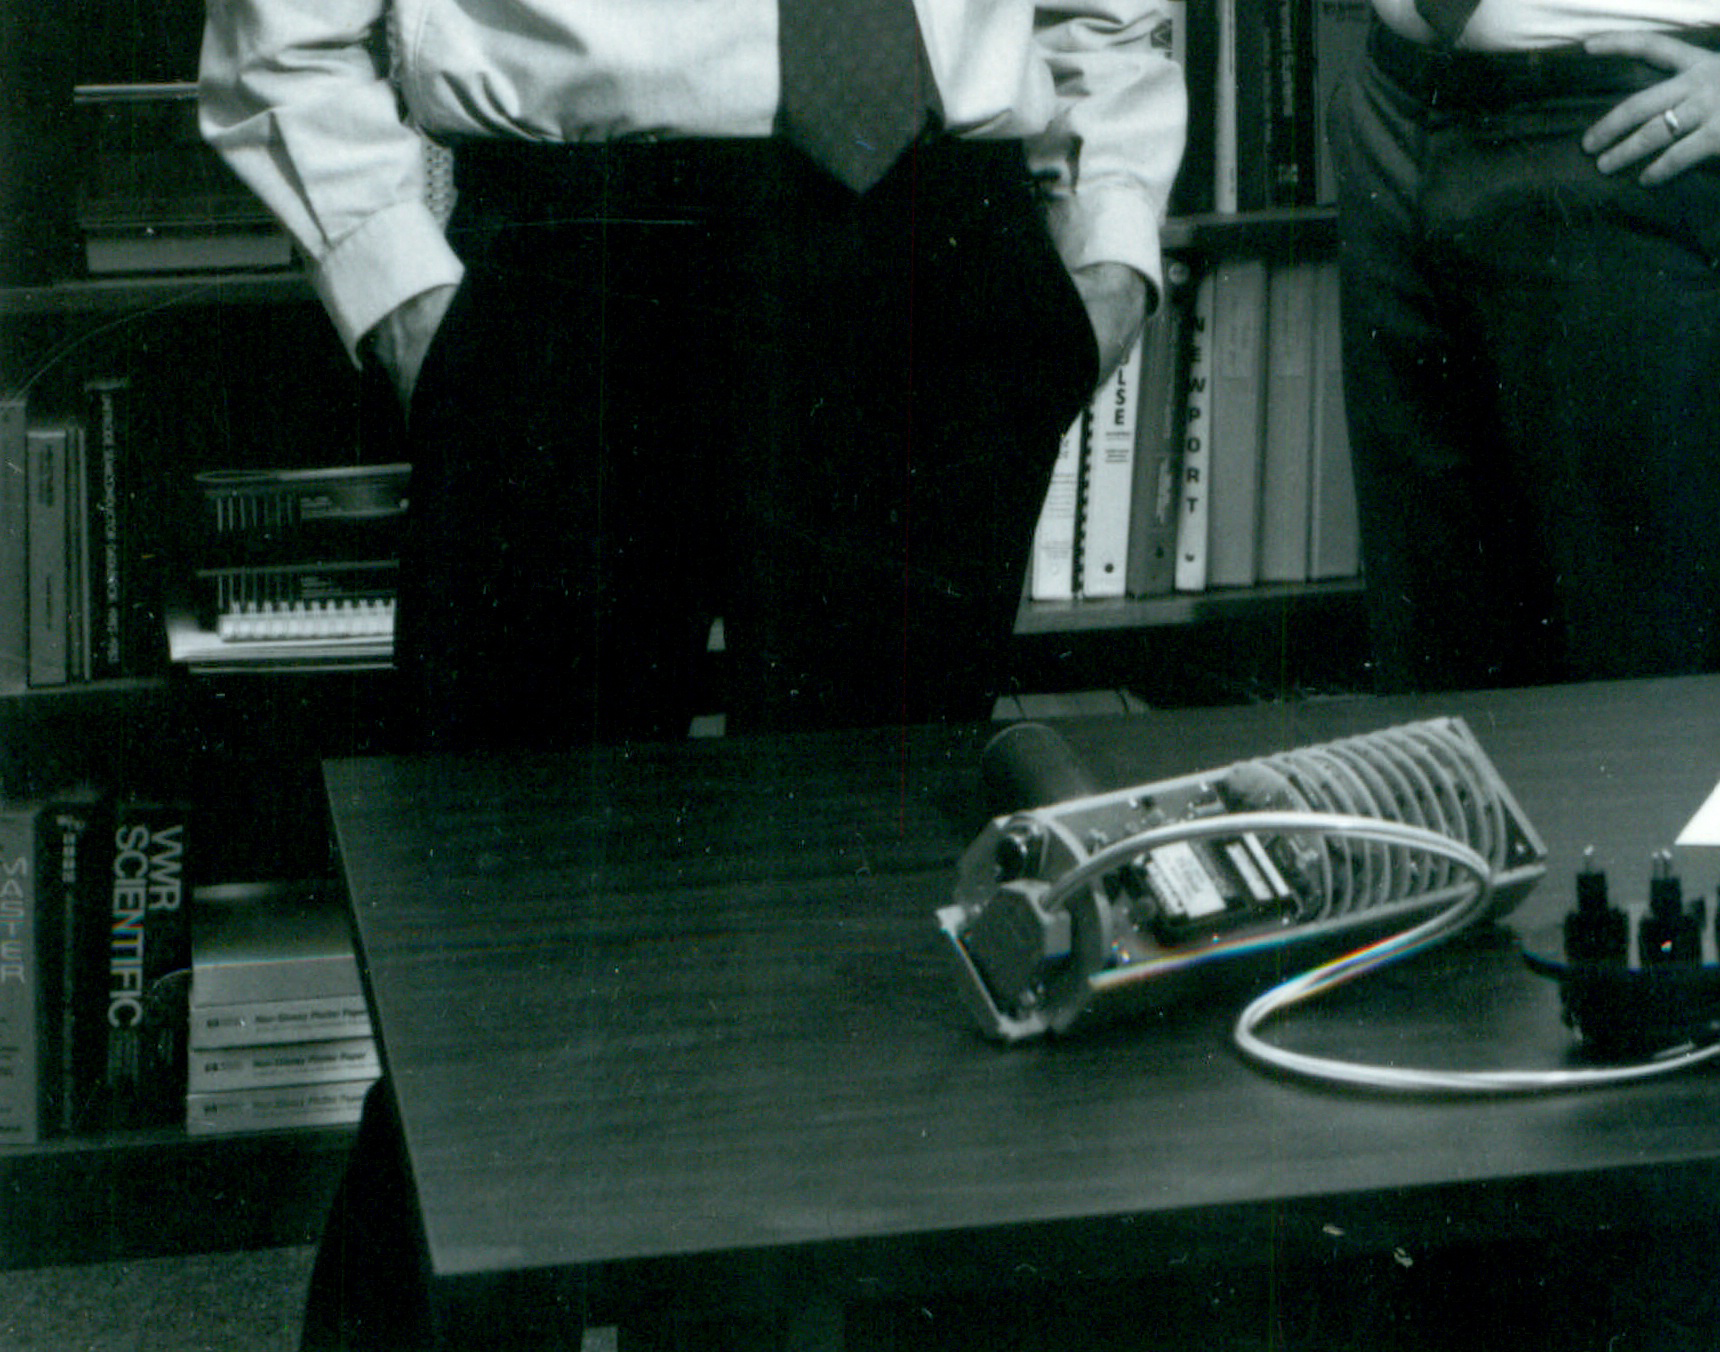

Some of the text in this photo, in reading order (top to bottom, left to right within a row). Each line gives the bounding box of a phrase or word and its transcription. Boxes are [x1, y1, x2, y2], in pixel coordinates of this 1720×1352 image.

[1185, 314, 1206, 516] NEWPORT
[0, 857, 27, 984] MASTER
[108, 824, 148, 1028] SCIENTIFIC
[150, 824, 184, 911] VWR
